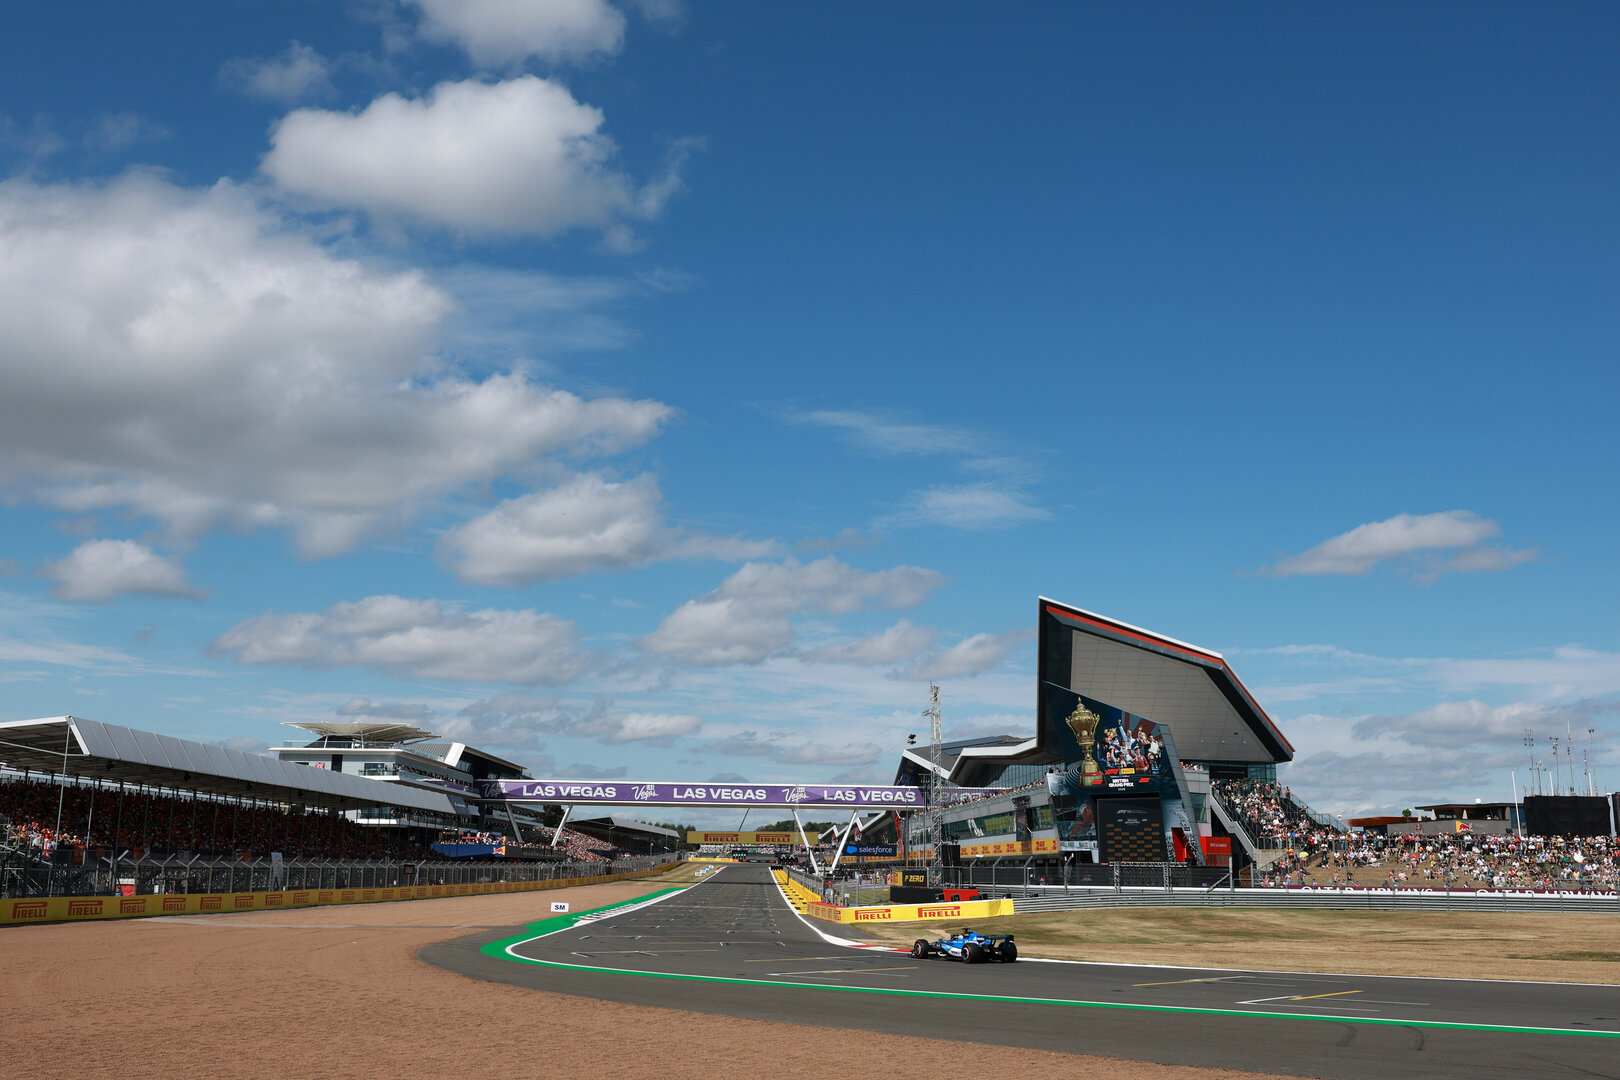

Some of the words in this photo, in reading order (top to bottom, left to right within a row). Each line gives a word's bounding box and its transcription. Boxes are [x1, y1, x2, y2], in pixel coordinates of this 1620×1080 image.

[522, 785, 556, 797] LAS
[559, 785, 617, 798] VEGAS
[673, 788, 706, 799] LAS
[709, 788, 767, 800] VEGAS
[824, 790, 857, 801] LAS
[859, 790, 917, 802] VEGAS
[704, 833, 739, 842] PIRELLI
[755, 833, 790, 843] PIRELLI
[859, 845, 893, 855] salesforce
[904, 874, 909, 882] P
[909, 874, 924, 883] ZERO
[68, 900, 103, 916] PIRELLI
[120, 898, 147, 914] PIRELLI
[163, 897, 187, 911] PIRELLI
[200, 896, 223, 910] PIRELLI
[12, 901, 48, 919] PIRELLI
[855, 908, 891, 920] PIRELLI
[917, 905, 960, 918] PIRELLI
